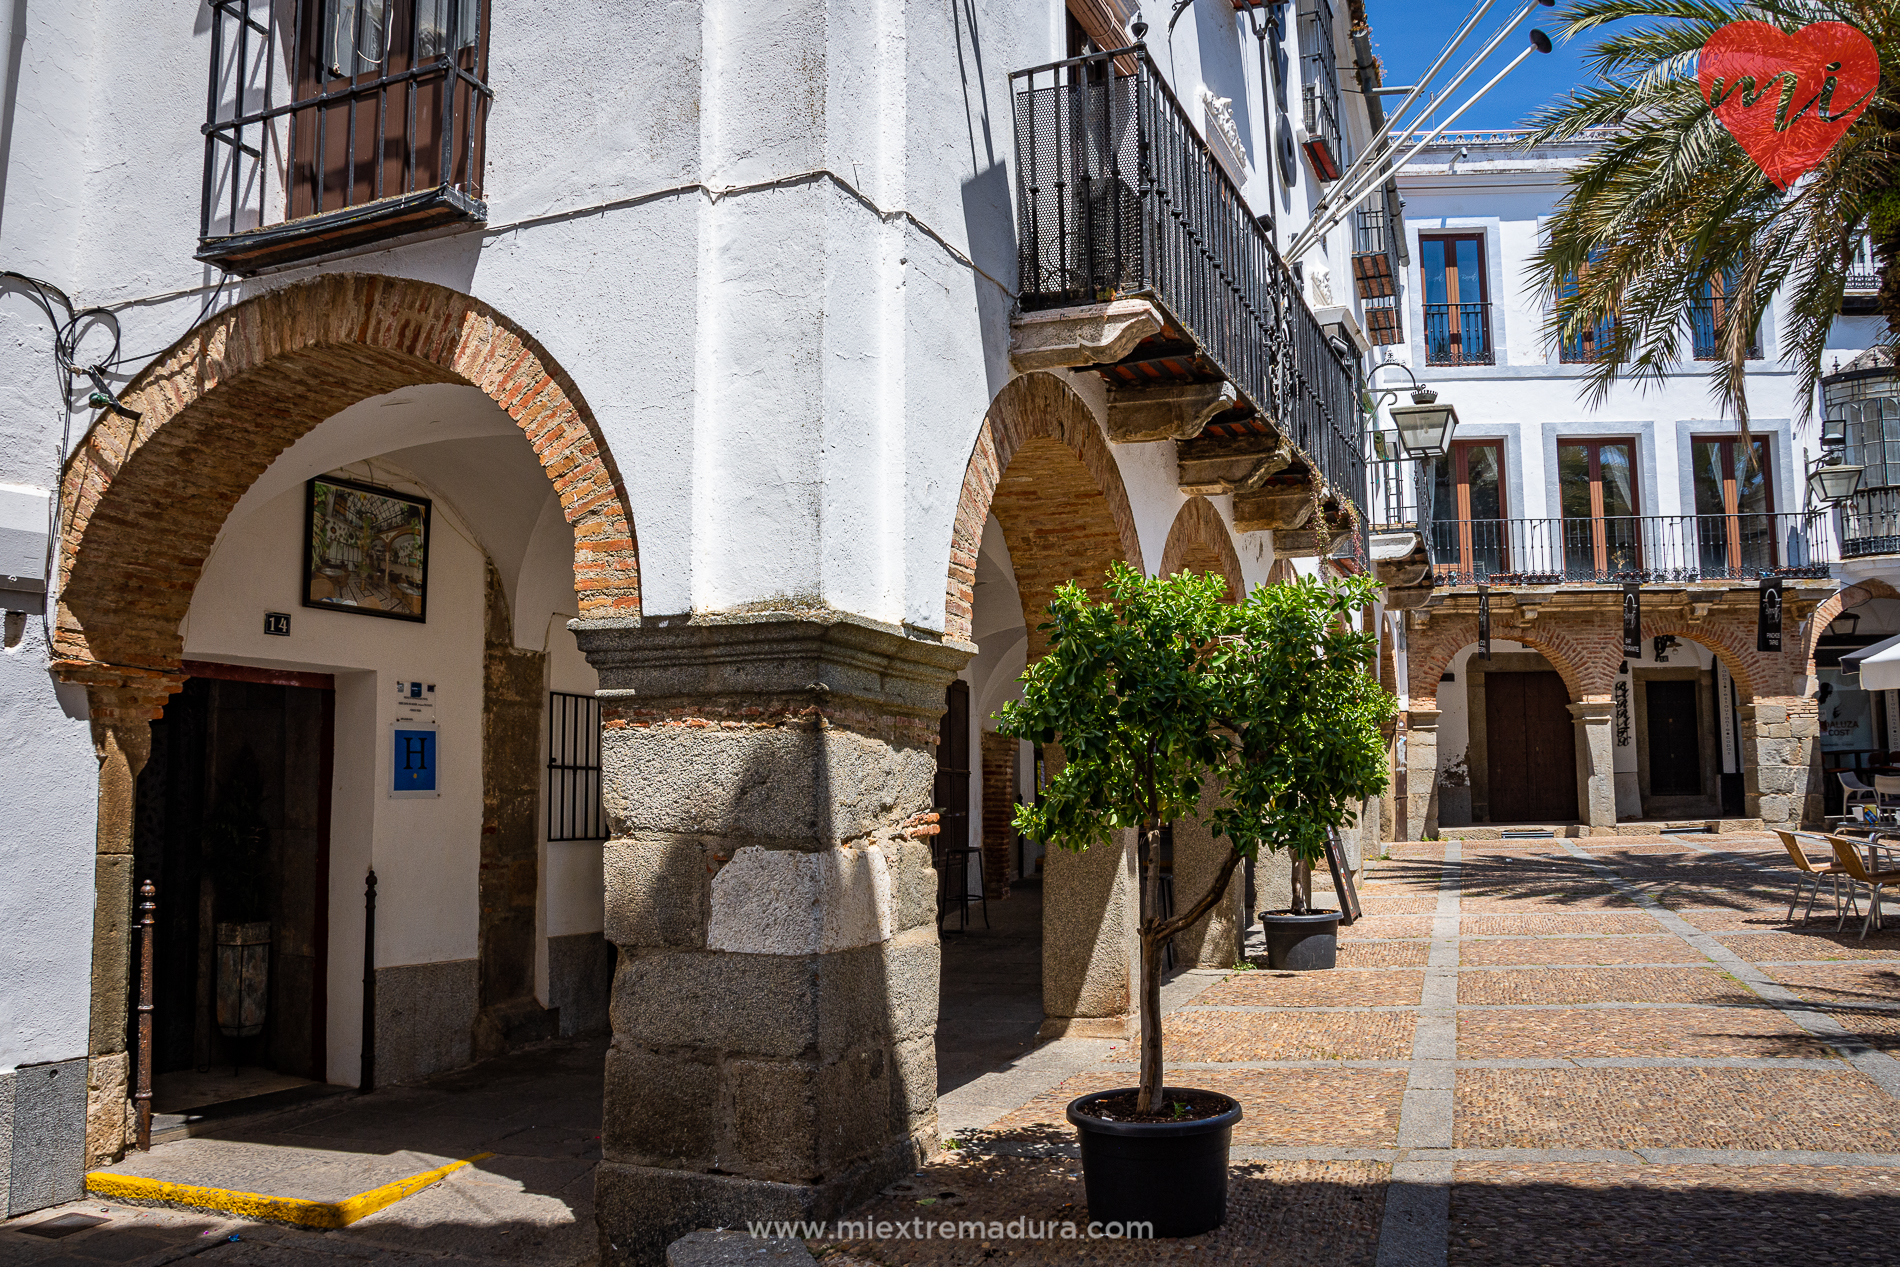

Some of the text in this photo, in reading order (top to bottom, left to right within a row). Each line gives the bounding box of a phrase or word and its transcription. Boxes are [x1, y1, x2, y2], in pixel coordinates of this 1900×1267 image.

[269, 616, 288, 632] 14
[1889, 690, 1898, 730] estaurante
[1828, 729, 1851, 737] COST
[403, 737, 427, 769] H
